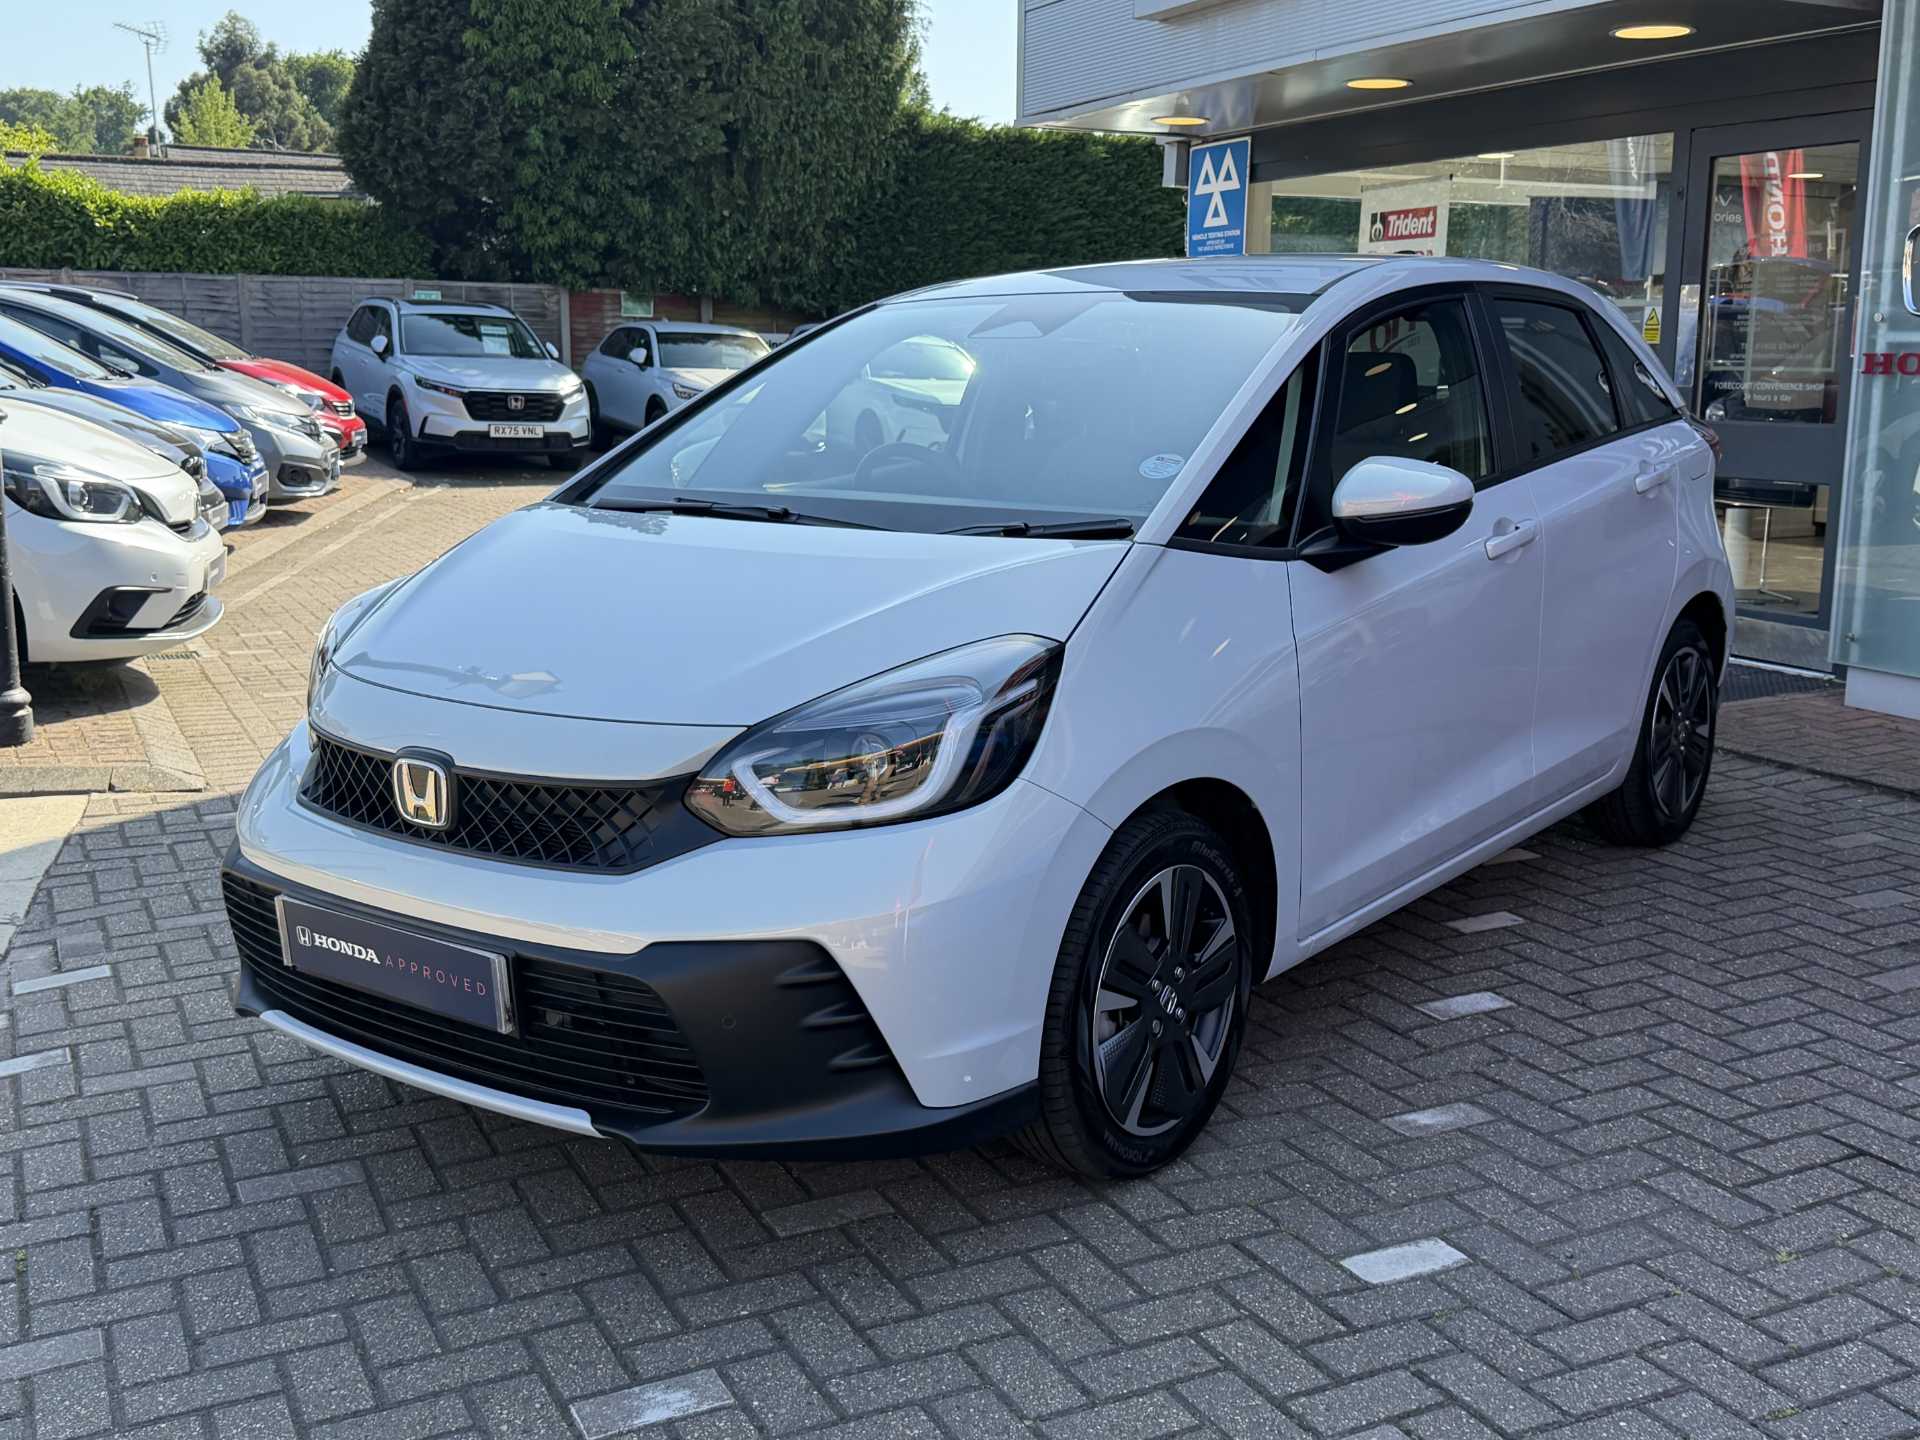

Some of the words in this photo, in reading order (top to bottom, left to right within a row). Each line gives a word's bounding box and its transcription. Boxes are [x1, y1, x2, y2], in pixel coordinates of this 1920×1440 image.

[1387, 210, 1434, 237] Trident
[494, 425, 519, 436] RX75
[522, 426, 540, 436] VNL
[312, 932, 381, 965] HONDA
[385, 955, 486, 996] APPROVED
